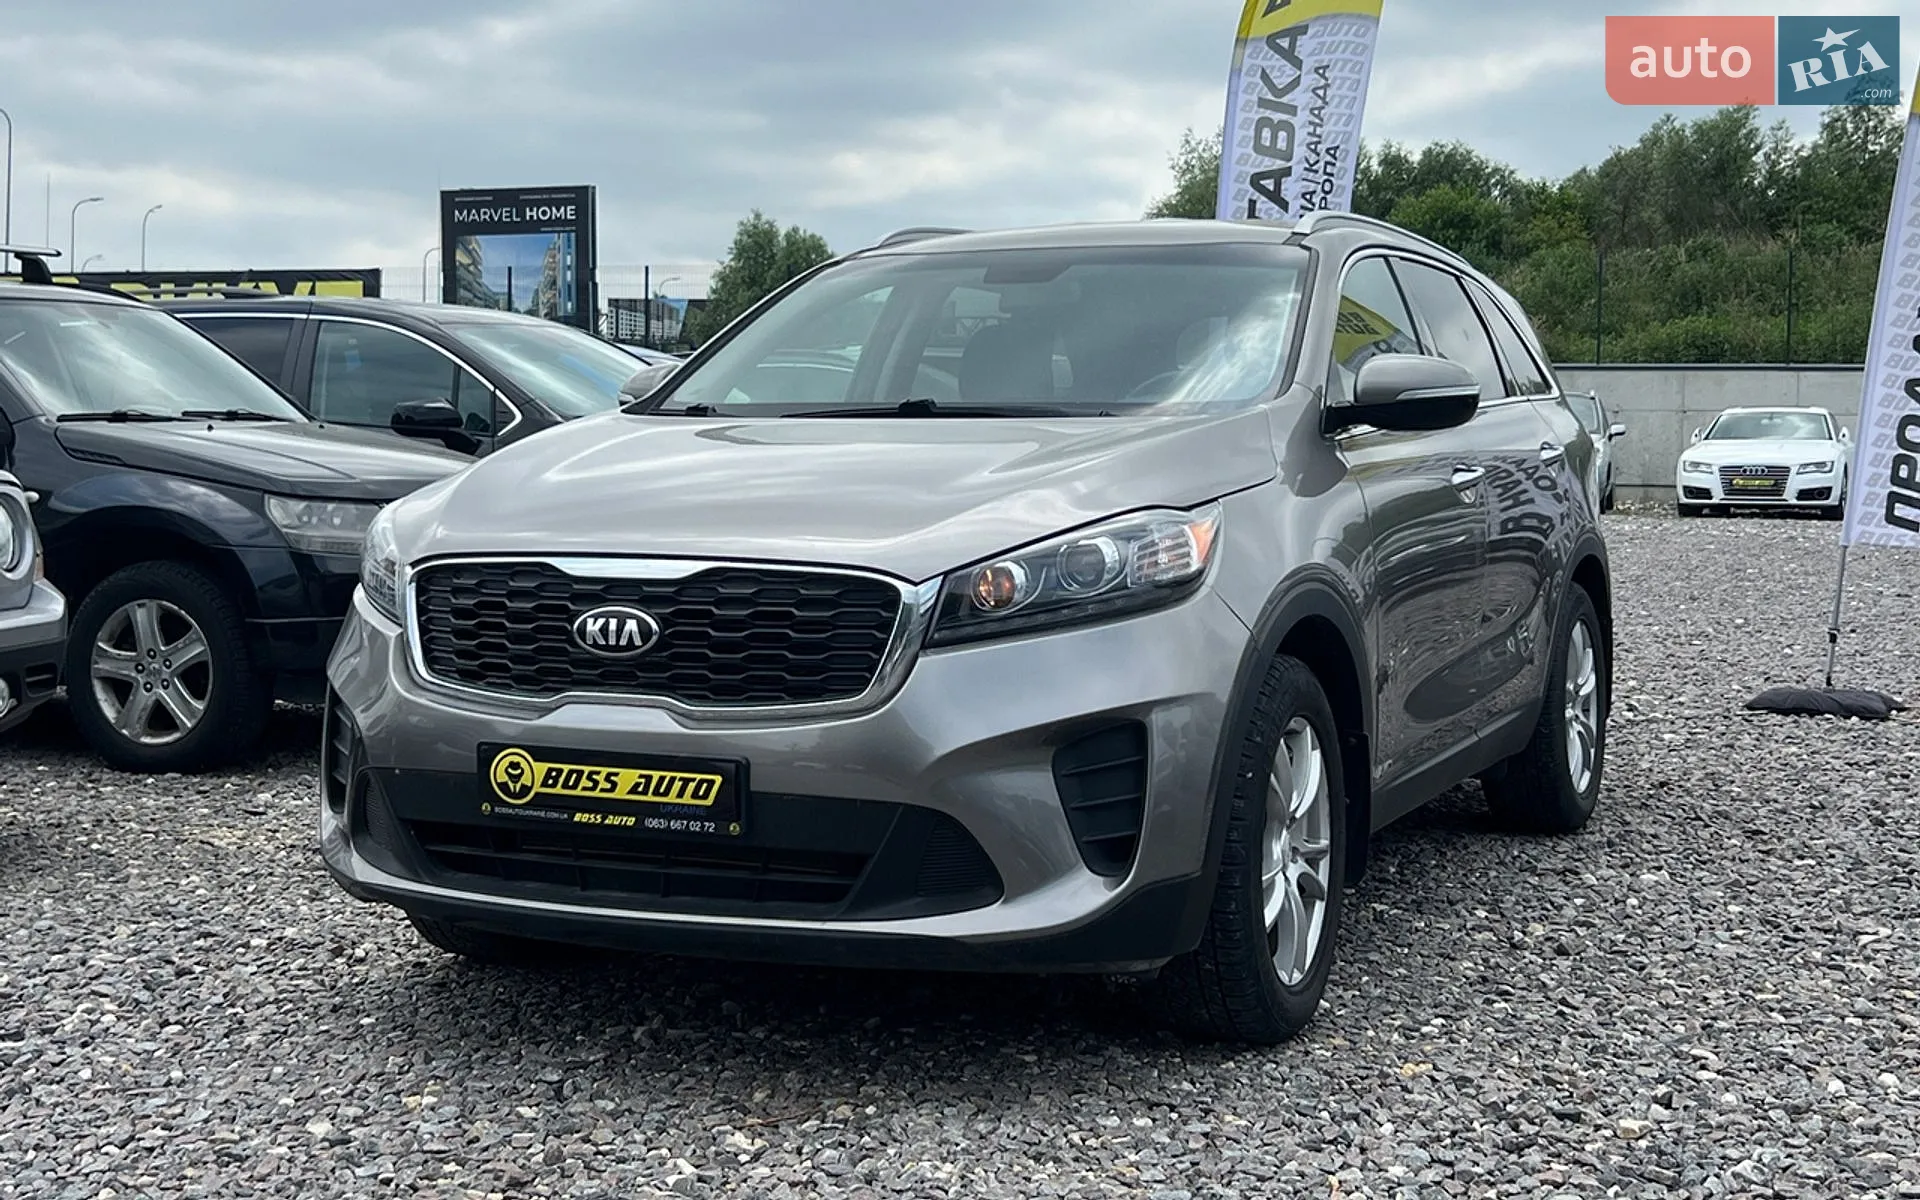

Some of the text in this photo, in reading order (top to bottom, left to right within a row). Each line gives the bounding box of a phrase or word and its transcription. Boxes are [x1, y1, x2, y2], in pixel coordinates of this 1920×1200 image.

[1304, 64, 1331, 174] КАНАДА
[454, 205, 576, 223] MARVEL HOME
[586, 617, 643, 646] KIA
[540, 767, 717, 800] BOSS AUTO
[573, 812, 636, 826] BOSS AUTO
[703, 822, 715, 833] 72
